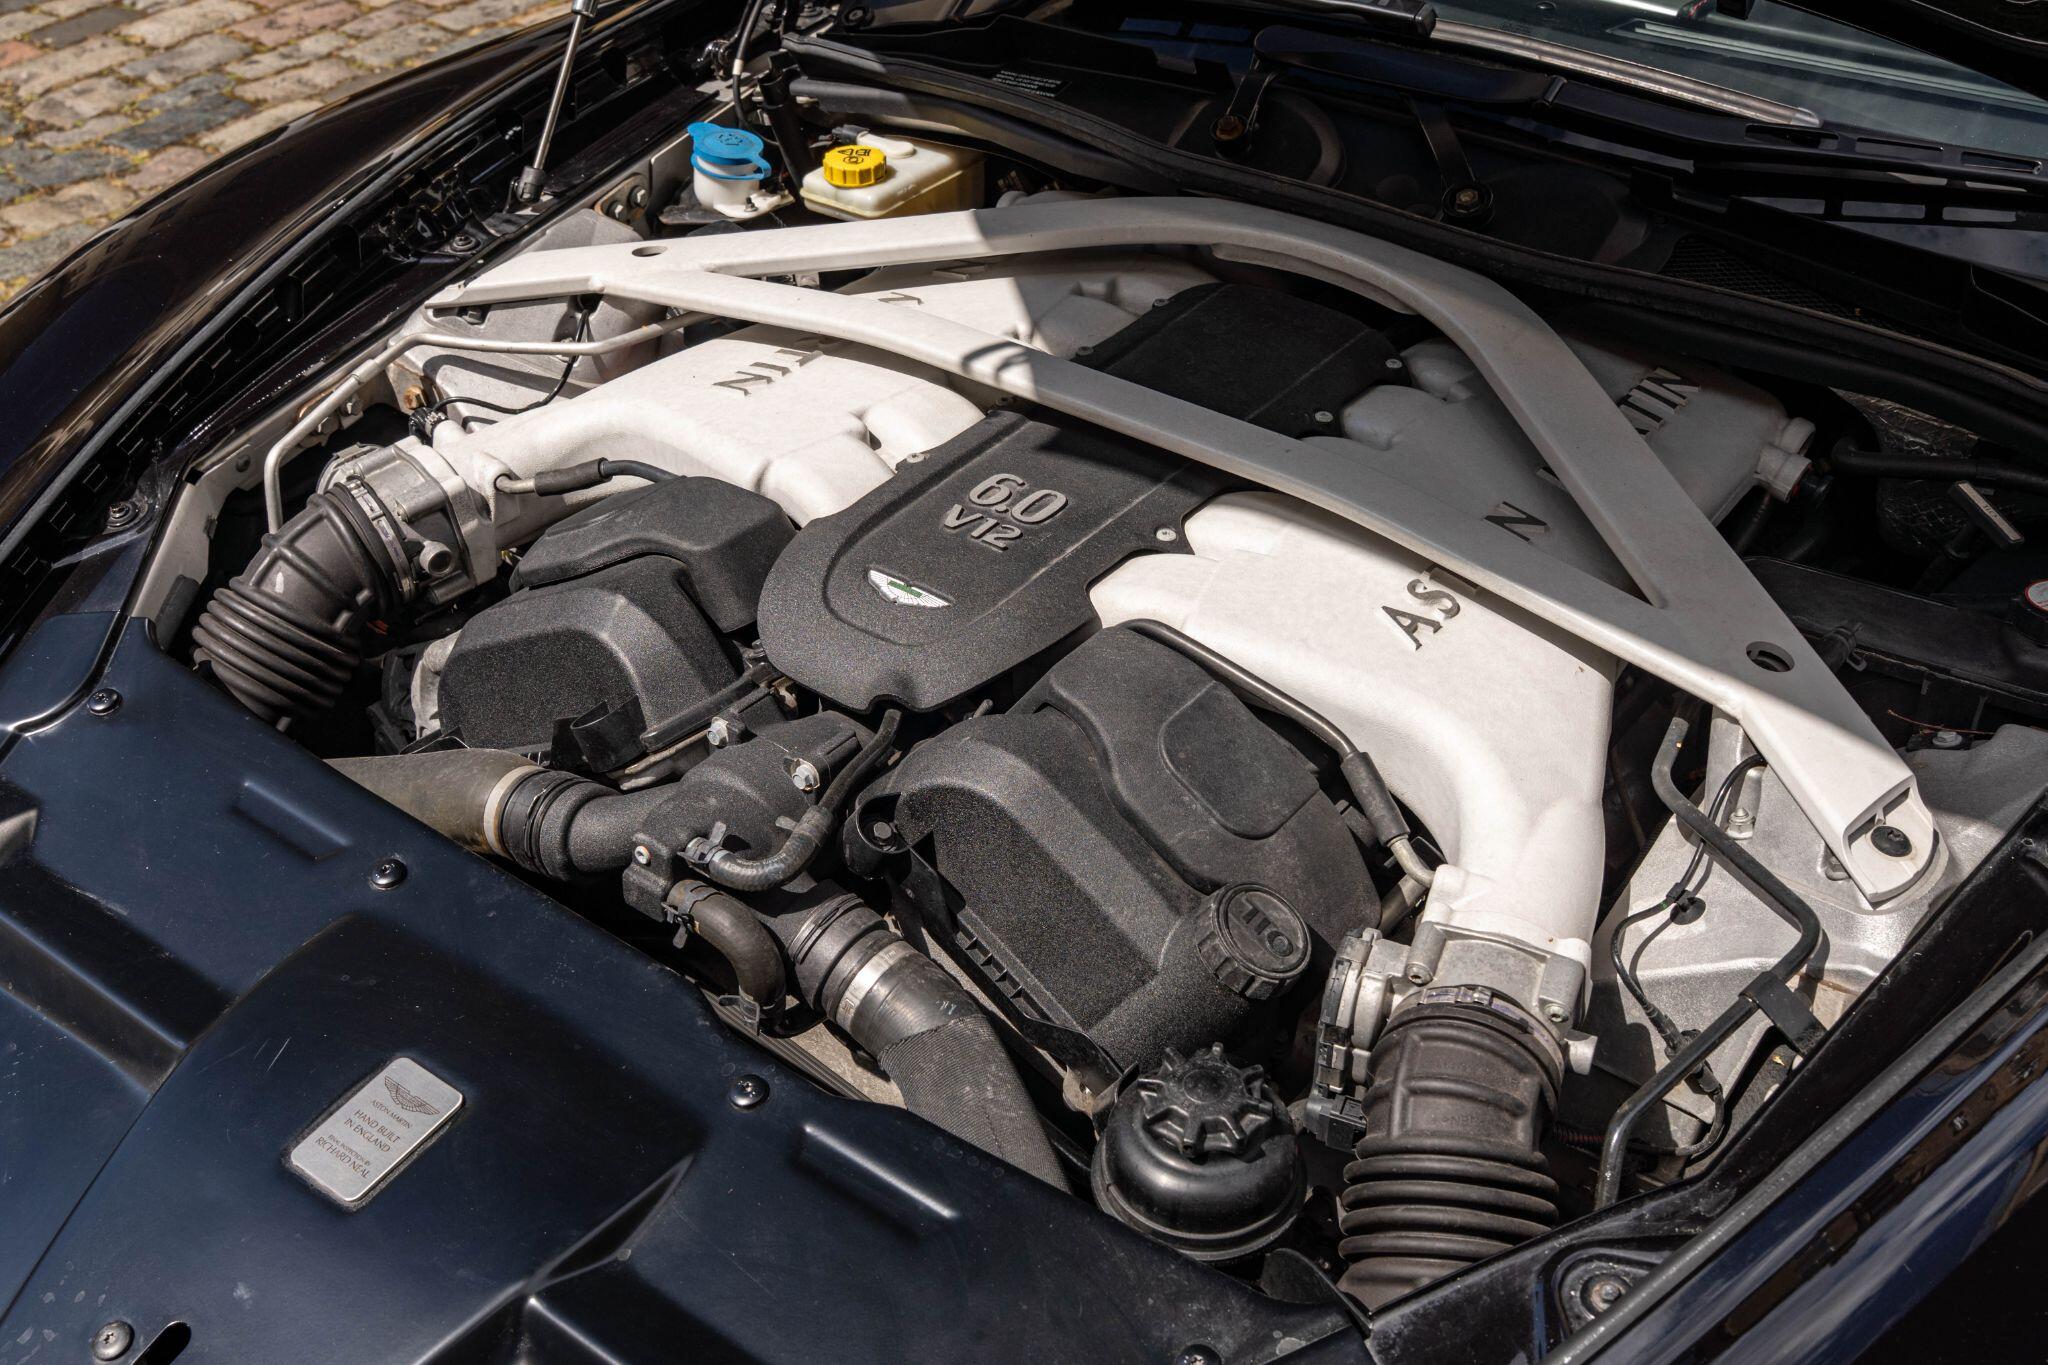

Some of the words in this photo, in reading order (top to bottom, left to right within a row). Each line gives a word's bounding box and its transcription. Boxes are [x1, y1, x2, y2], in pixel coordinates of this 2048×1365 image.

[968, 473, 1069, 525] 6.0
[943, 503, 1024, 551] V12
[1240, 893, 1294, 958] OIL
[343, 1118, 353, 1128] IN
[352, 1124, 391, 1152] ENGLAND
[353, 1109, 379, 1128] HAND
[377, 1125, 401, 1143] BUILT
[372, 1099, 391, 1115] ASTON
[389, 1111, 412, 1129] MARTIN
[315, 1136, 352, 1163] RICHARD
[351, 1160, 370, 1179] NEAL
